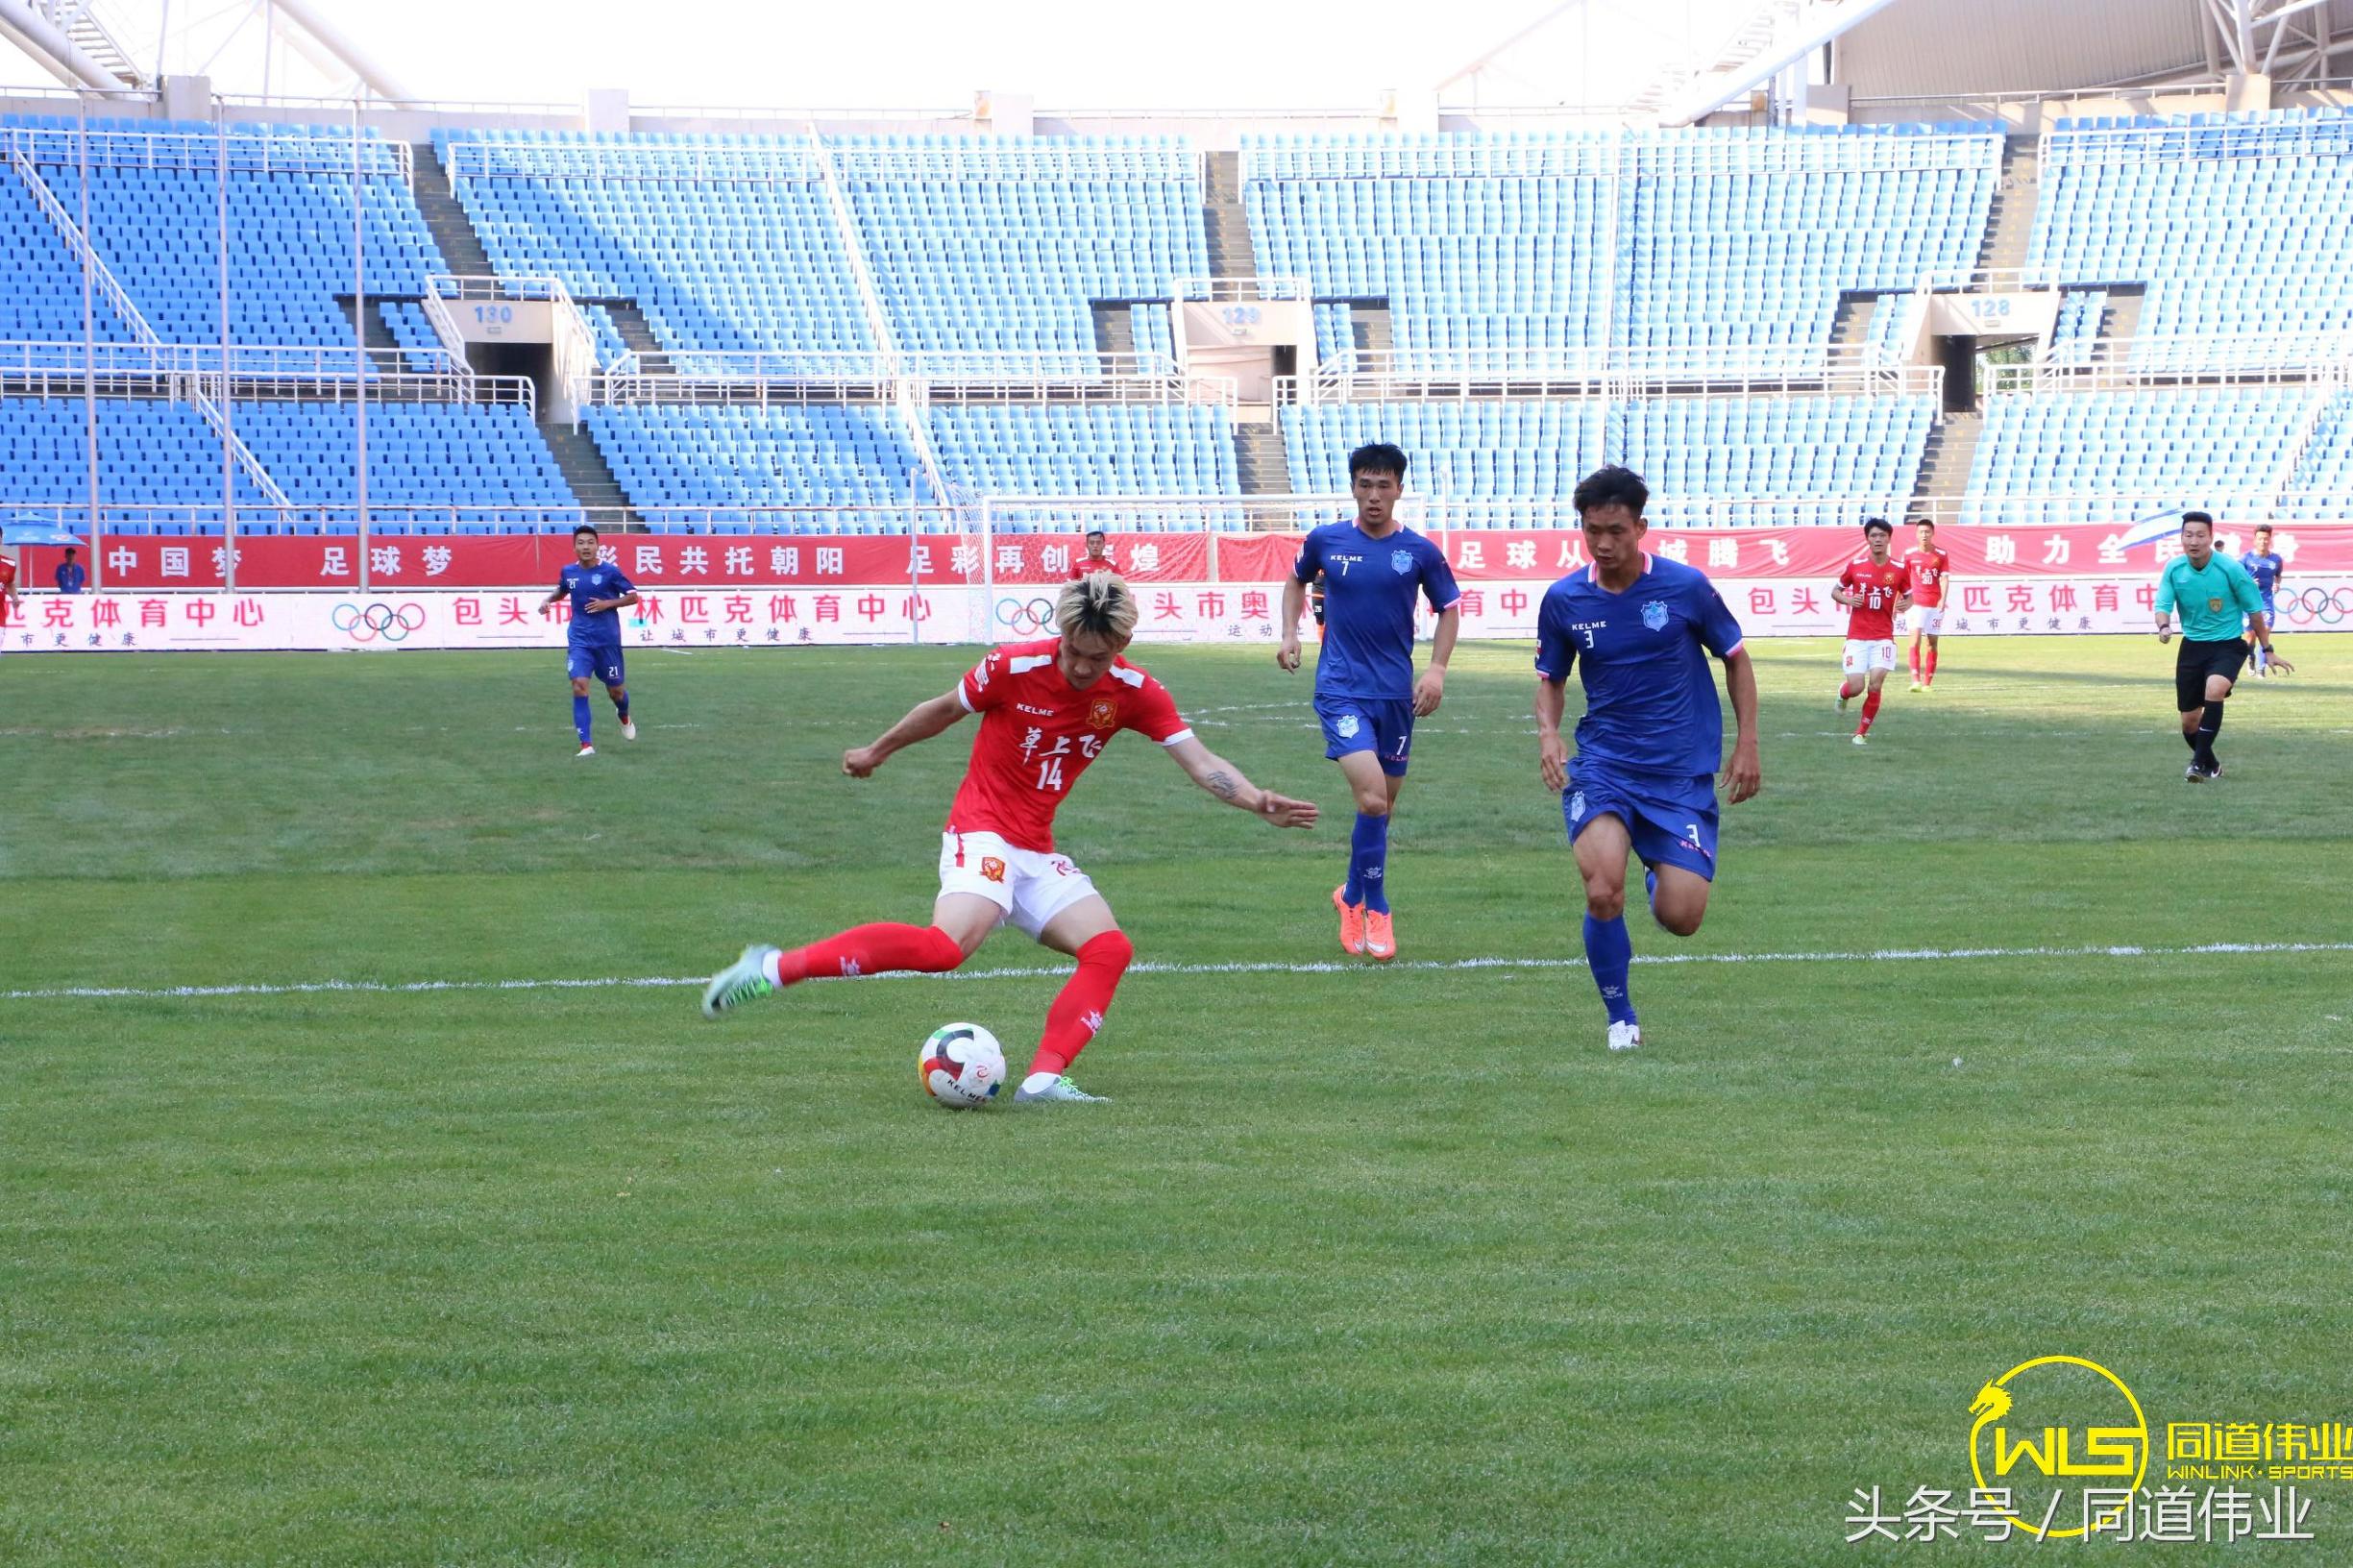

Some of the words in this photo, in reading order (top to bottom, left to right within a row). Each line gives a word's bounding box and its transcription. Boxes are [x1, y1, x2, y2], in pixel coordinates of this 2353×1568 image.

[474, 306, 513, 324] 130
[1972, 300, 2010, 317] 128
[108, 546, 242, 577] 中国梦
[320, 546, 452, 576] 足球梦
[906, 543, 1161, 576] 足彩再创煌
[1341, 561, 1350, 576] 7
[1869, 596, 1881, 610] 10
[1571, 621, 1607, 630] KELME
[1583, 629, 1595, 649] 3
[1881, 645, 1892, 659] 10
[608, 666, 619, 677] 21
[1017, 702, 1055, 717] KELME
[1019, 726, 1102, 765] 草上飞
[1396, 735, 1408, 756] 7
[1037, 757, 1063, 791] 14
[947, 1079, 985, 1102] KELME
